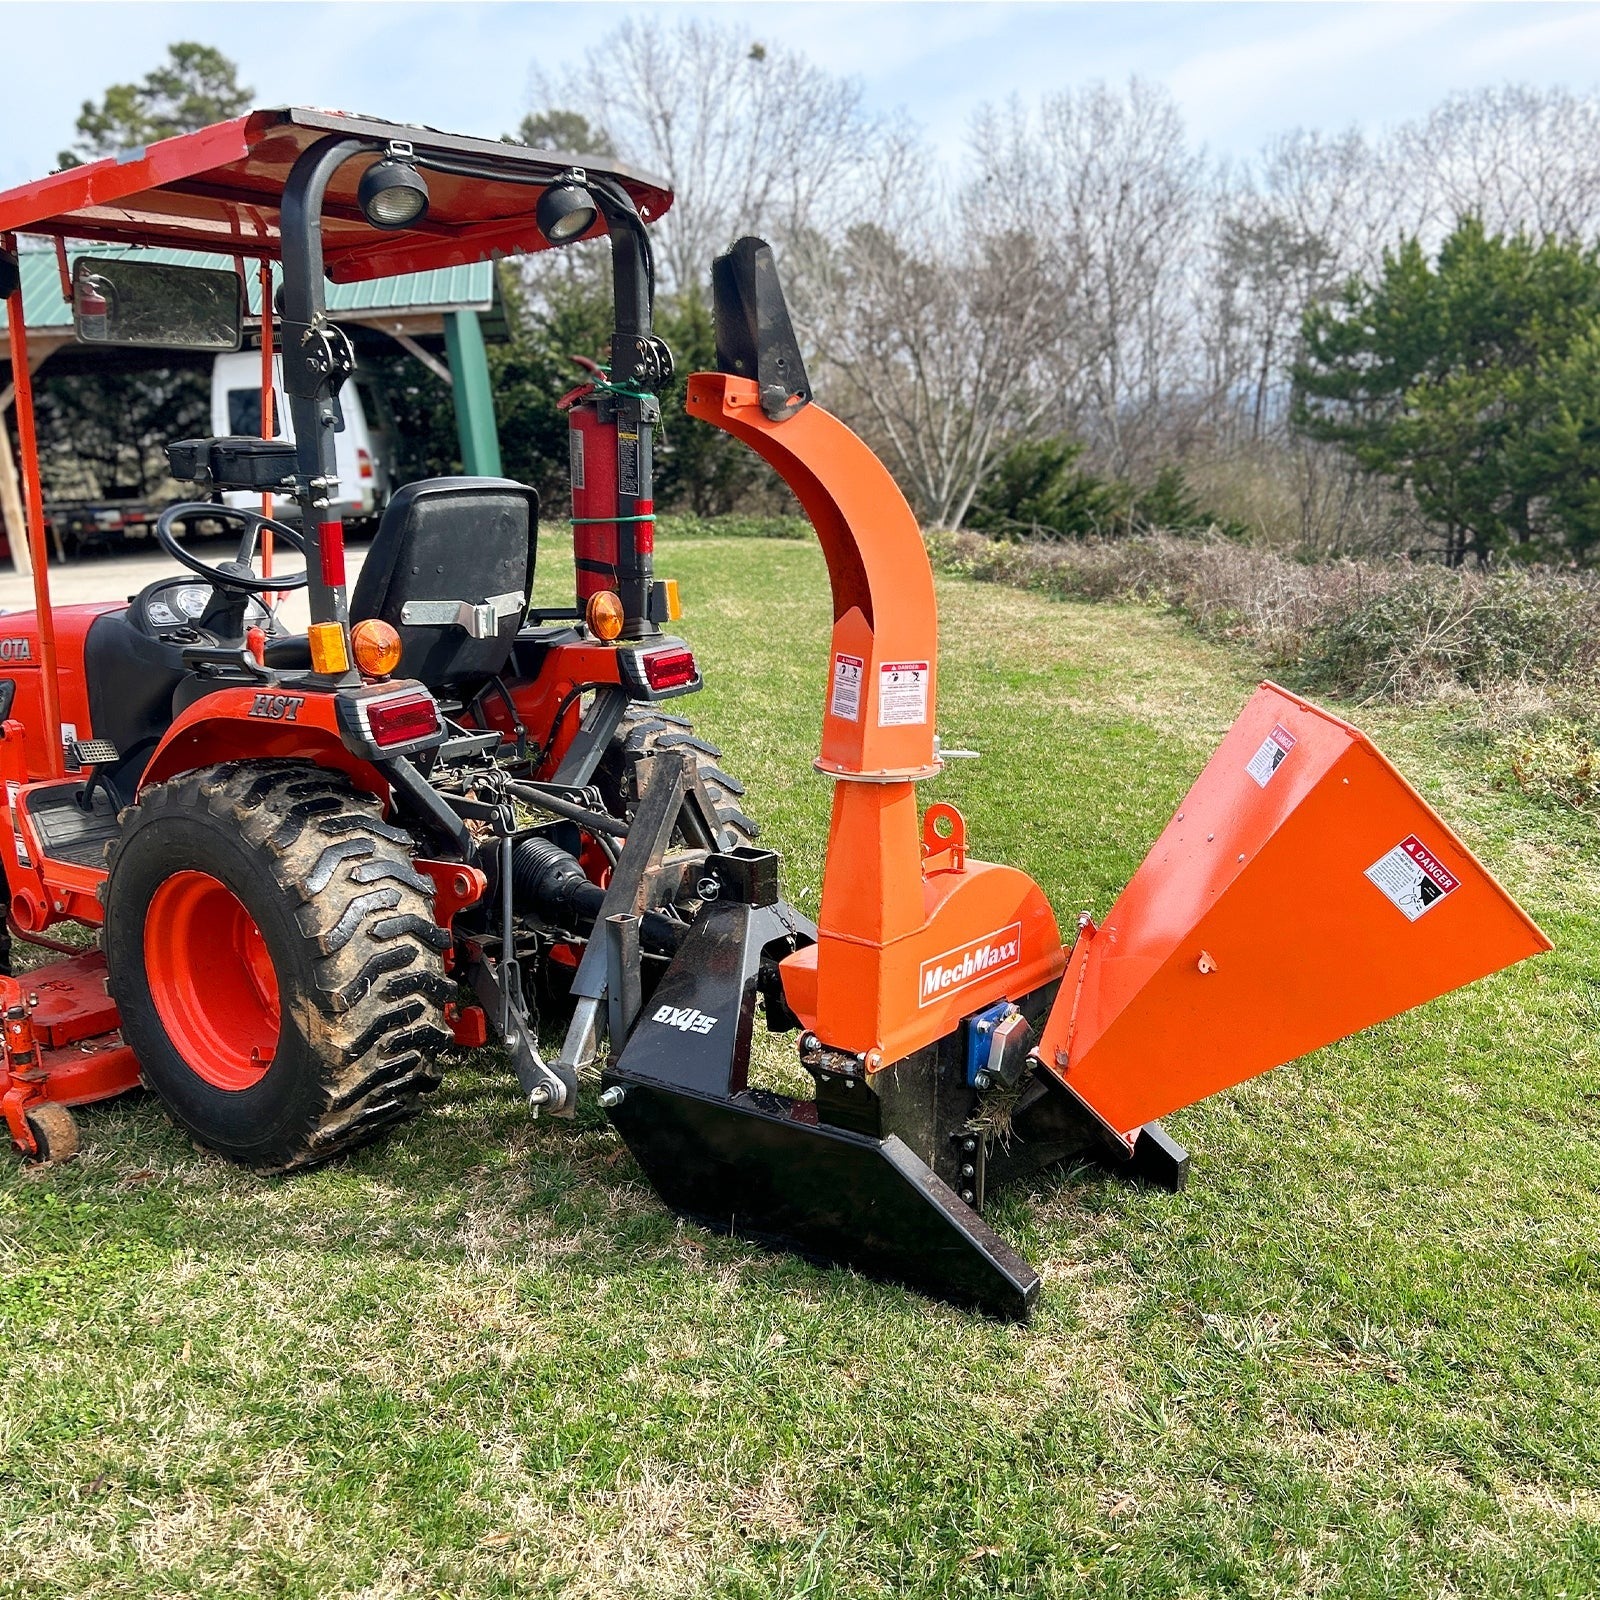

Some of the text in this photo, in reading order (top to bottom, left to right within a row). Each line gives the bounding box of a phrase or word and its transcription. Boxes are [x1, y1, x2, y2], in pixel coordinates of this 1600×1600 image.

[248, 694, 304, 720] HST
[1415, 851, 1453, 889] DANGER
[923, 940, 1017, 997] MechMaxx
